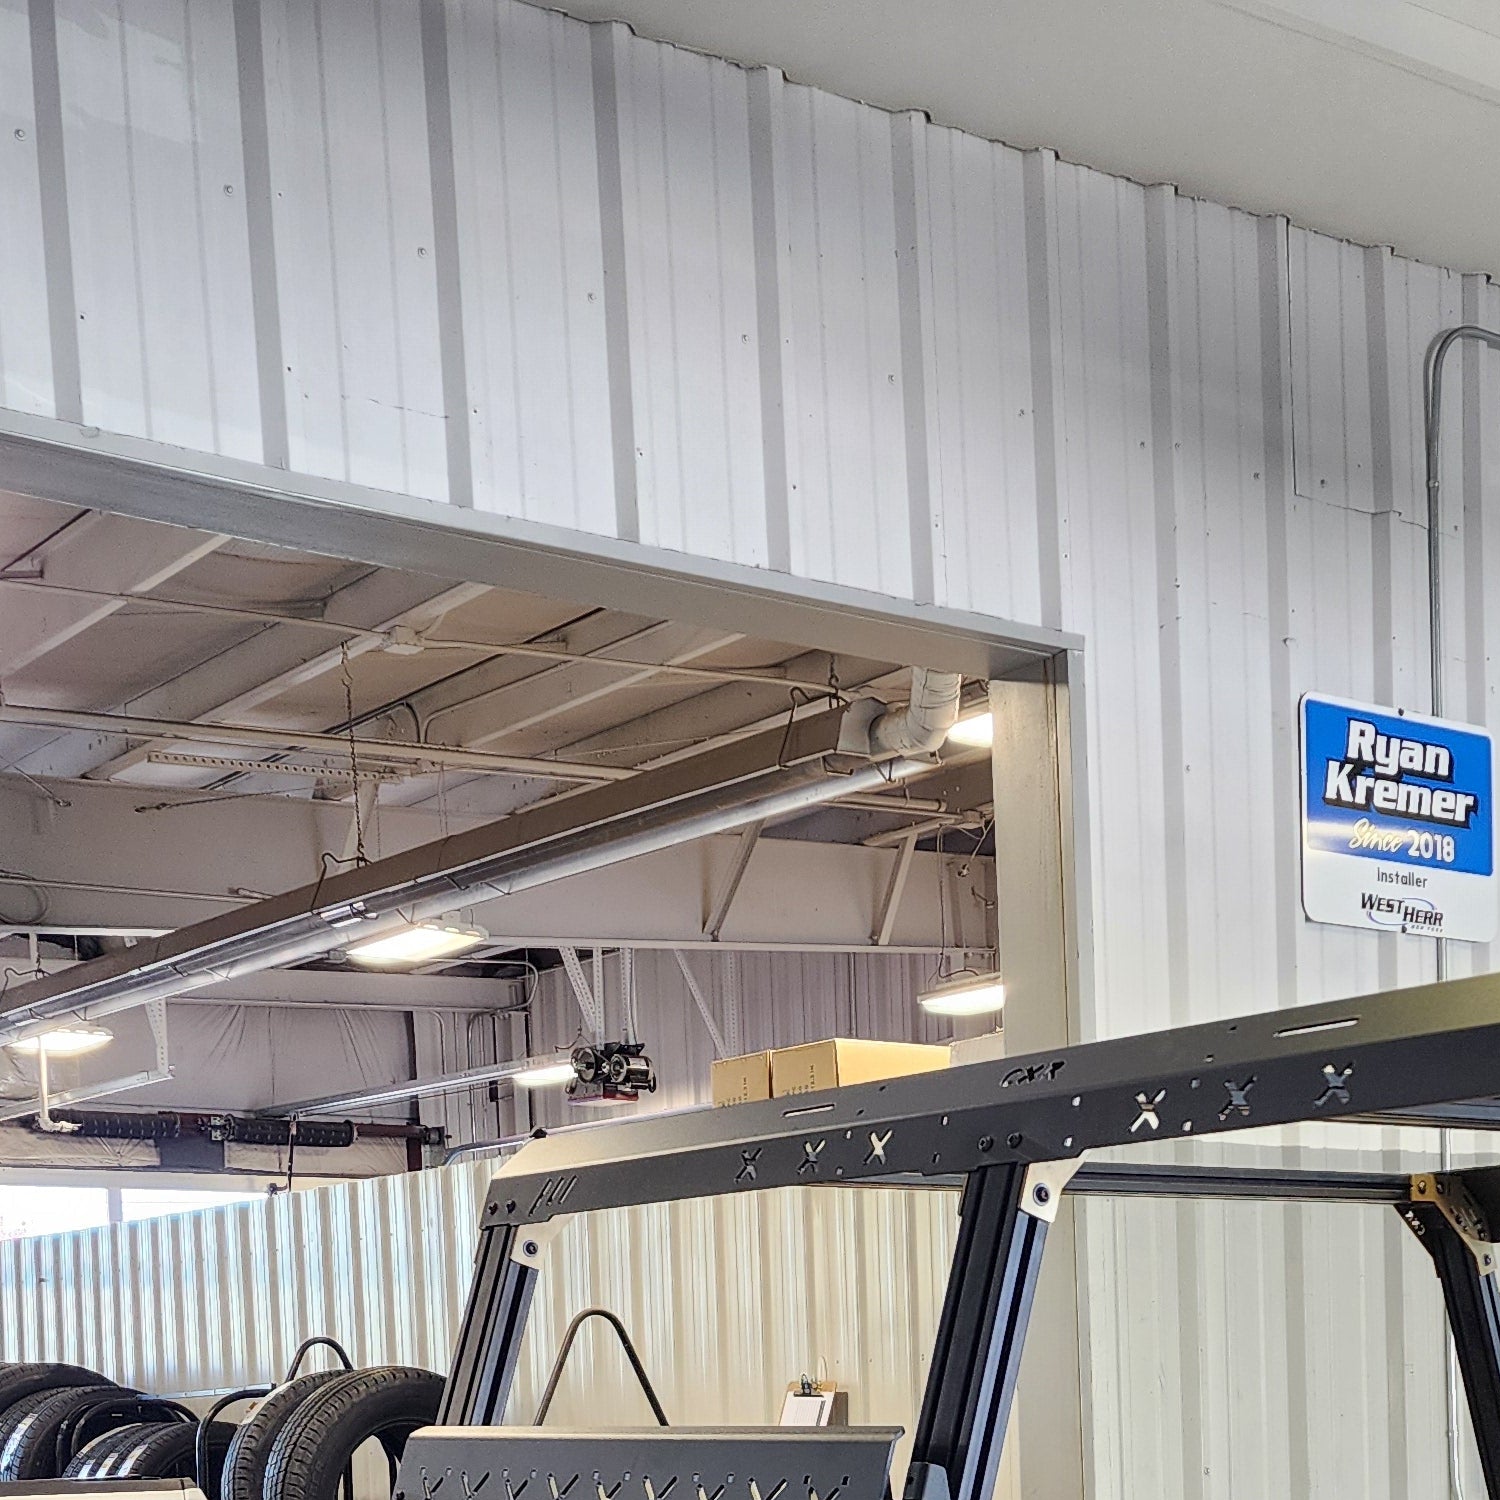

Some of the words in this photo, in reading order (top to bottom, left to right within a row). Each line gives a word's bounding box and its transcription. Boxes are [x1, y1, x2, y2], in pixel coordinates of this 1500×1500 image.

[1347, 718, 1452, 779] Ryan
[1324, 760, 1475, 823] Kremer
[1349, 818, 1403, 853] Since
[1408, 829, 1455, 863] 2018
[1377, 866, 1428, 889] Installer
